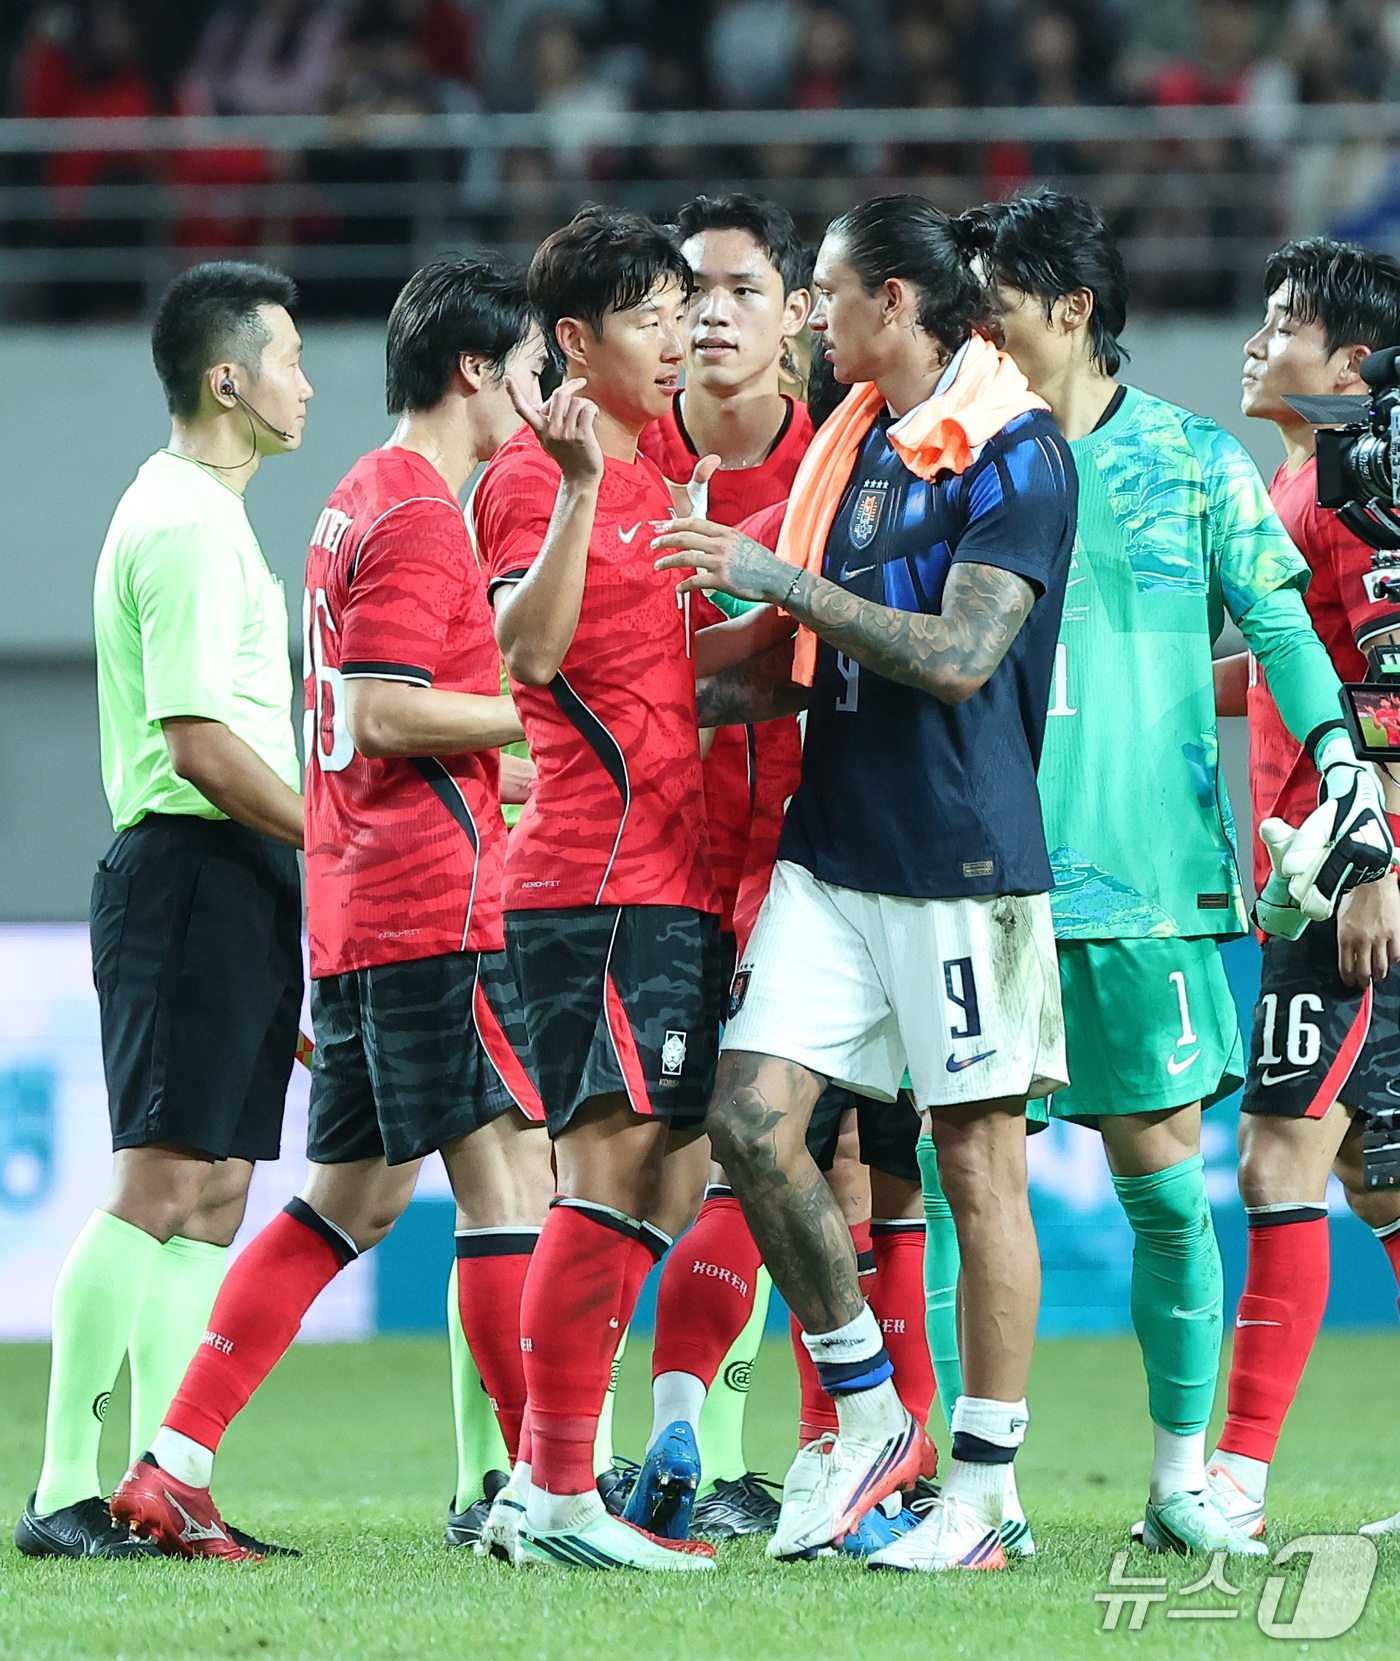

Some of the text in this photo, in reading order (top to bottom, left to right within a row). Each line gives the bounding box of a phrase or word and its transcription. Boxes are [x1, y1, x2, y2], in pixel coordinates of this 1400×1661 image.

[1046, 643, 1078, 717] 1
[943, 956, 981, 1039] 9
[1168, 971, 1197, 1048] 1
[1256, 993, 1325, 1067] 16
